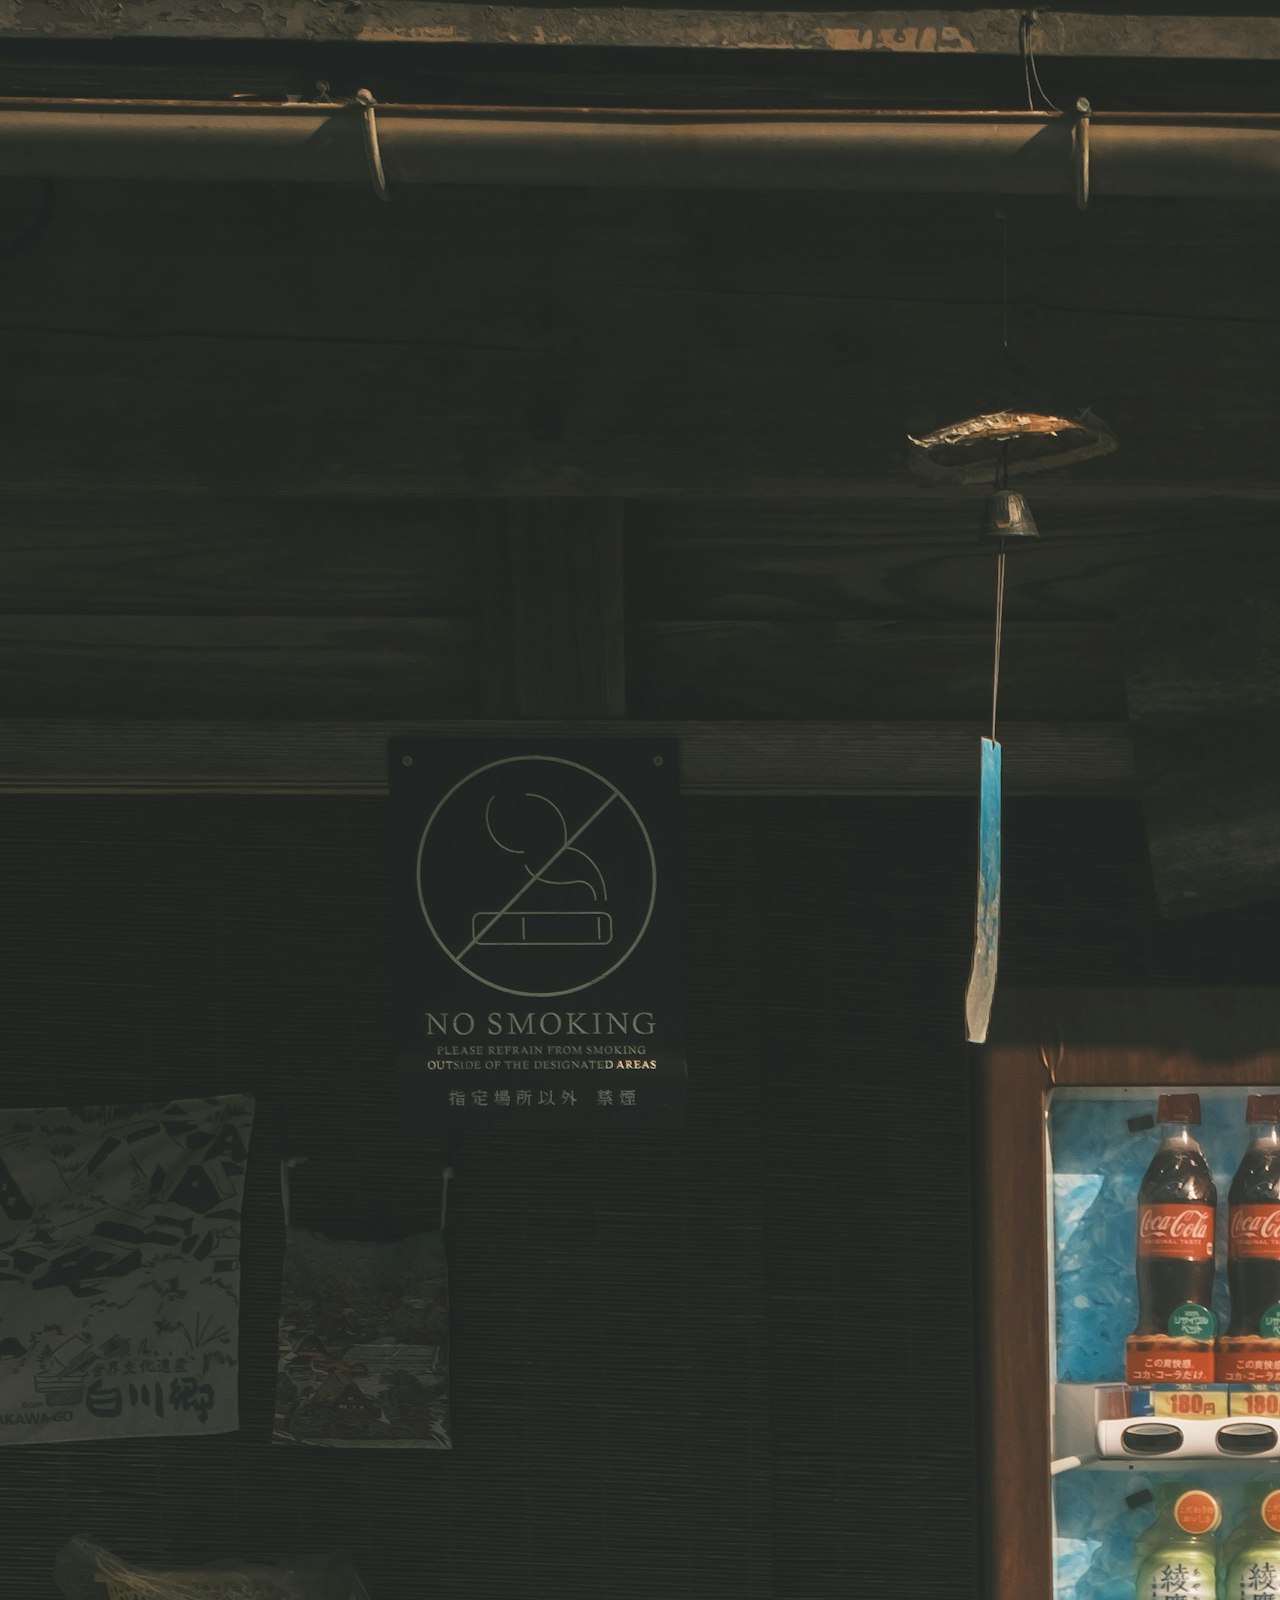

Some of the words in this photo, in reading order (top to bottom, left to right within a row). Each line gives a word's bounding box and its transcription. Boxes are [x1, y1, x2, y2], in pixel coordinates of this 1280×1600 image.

[424, 1012, 475, 1036] NO
[487, 1011, 657, 1036] SMOKING
[437, 1045, 484, 1056] PLEASE
[488, 1045, 543, 1056] REFRAIN
[547, 1045, 582, 1055] FROM
[586, 1045, 646, 1055] SMOKING
[427, 1060, 481, 1071] OUTSIDE
[485, 1060, 501, 1070] OF
[505, 1060, 529, 1070] THE
[534, 1060, 614, 1070] DESIGNATED
[616, 1060, 657, 1070] AREAS
[448, 1089, 577, 1107] 指定場所以外
[596, 1089, 638, 1107] 禁煙
[1140, 1210, 1208, 1240] Coca-Cola
